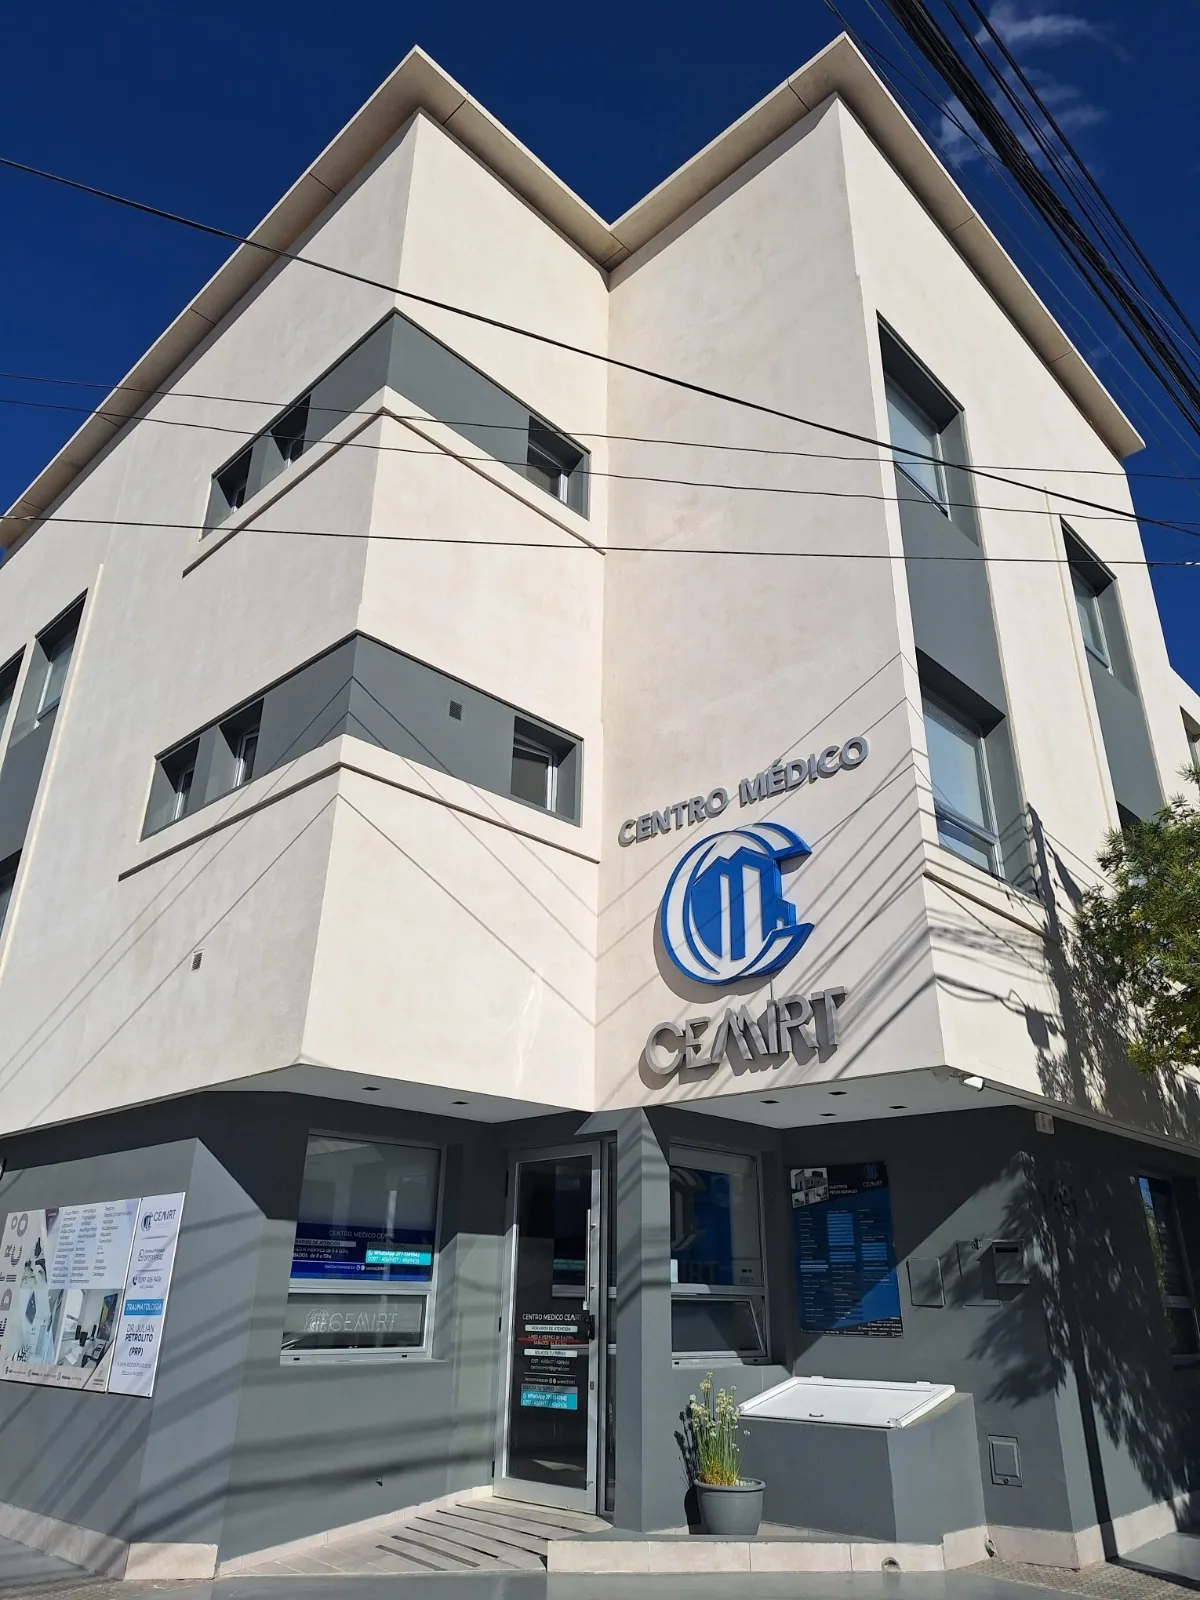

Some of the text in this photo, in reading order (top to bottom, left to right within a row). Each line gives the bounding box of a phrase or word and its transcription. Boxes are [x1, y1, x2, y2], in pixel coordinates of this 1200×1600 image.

[618, 736, 869, 847] CENTRO MÉDICO
[645, 986, 849, 1075] CEMIRT
[153, 1209, 177, 1222] CEMIRT
[329, 1230, 352, 1238] CENTRO
[522, 1313, 543, 1321] CENTRO
[124, 1333, 154, 1343] PETROLITO
[128, 1346, 144, 1357] (PRP)
